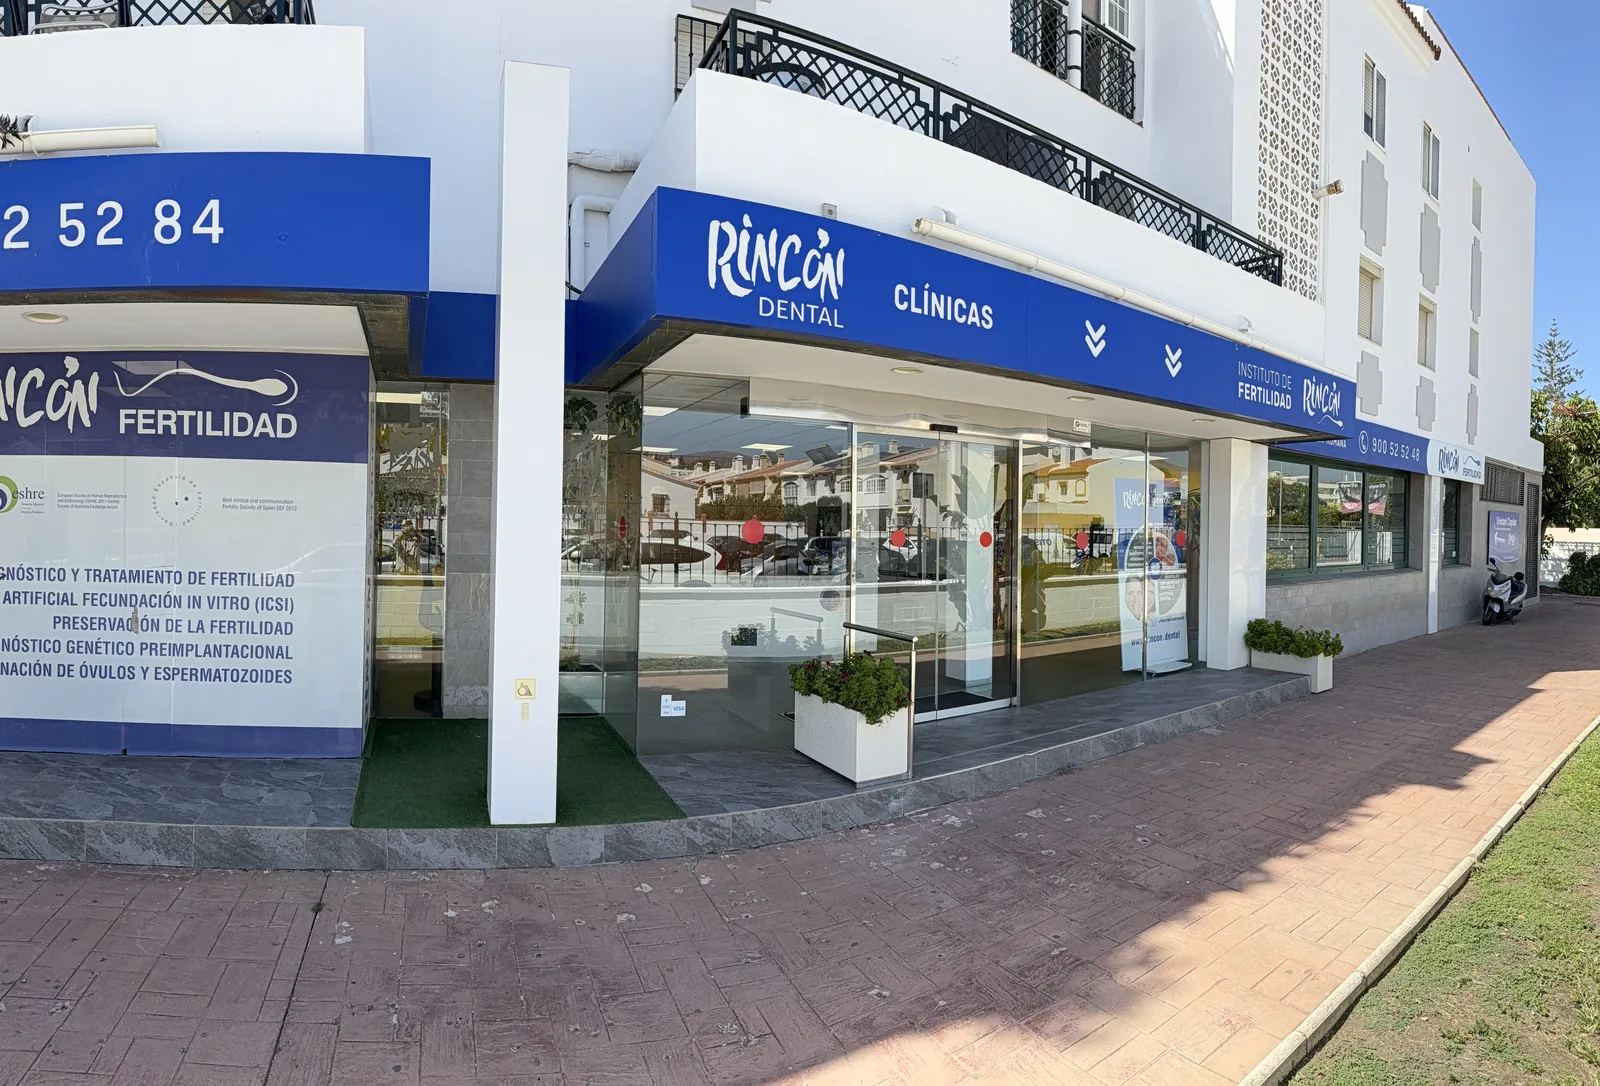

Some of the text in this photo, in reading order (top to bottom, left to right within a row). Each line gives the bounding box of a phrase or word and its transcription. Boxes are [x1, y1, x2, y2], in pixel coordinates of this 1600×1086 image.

[3, 198, 224, 249] 2 52 84
[759, 297, 844, 328] DENTAL
[894, 283, 994, 330] CLÍNICAS
[1238, 360, 1292, 390] INSTITUTO DE
[1238, 382, 1292, 410] FERTILIDAD
[119, 408, 298, 438] FERTILIDAD
[1372, 437, 1420, 462] 900 52 52 48
[1462, 468, 1482, 480] FERTILIDAD
[12, 487, 45, 500] eshre
[70, 568, 80, 583] Y
[84, 568, 182, 585] TRATAMIENTO
[188, 572, 206, 586] DE
[211, 572, 295, 587] FERTILIDAD
[3, 590, 295, 614] ARTIFICIAL FECUNDACIÓN IN VITRO (ICSI)
[53, 613, 294, 636] PRESERVACÓN DE LA FERTILIDAD
[1, 637, 293, 660] NÓSTICO GENÉTICO PREIMPLANTACIONAL
[0, 661, 292, 684] NACIÓN DE ÓVULOS Y ESPERMATOZOIDES
